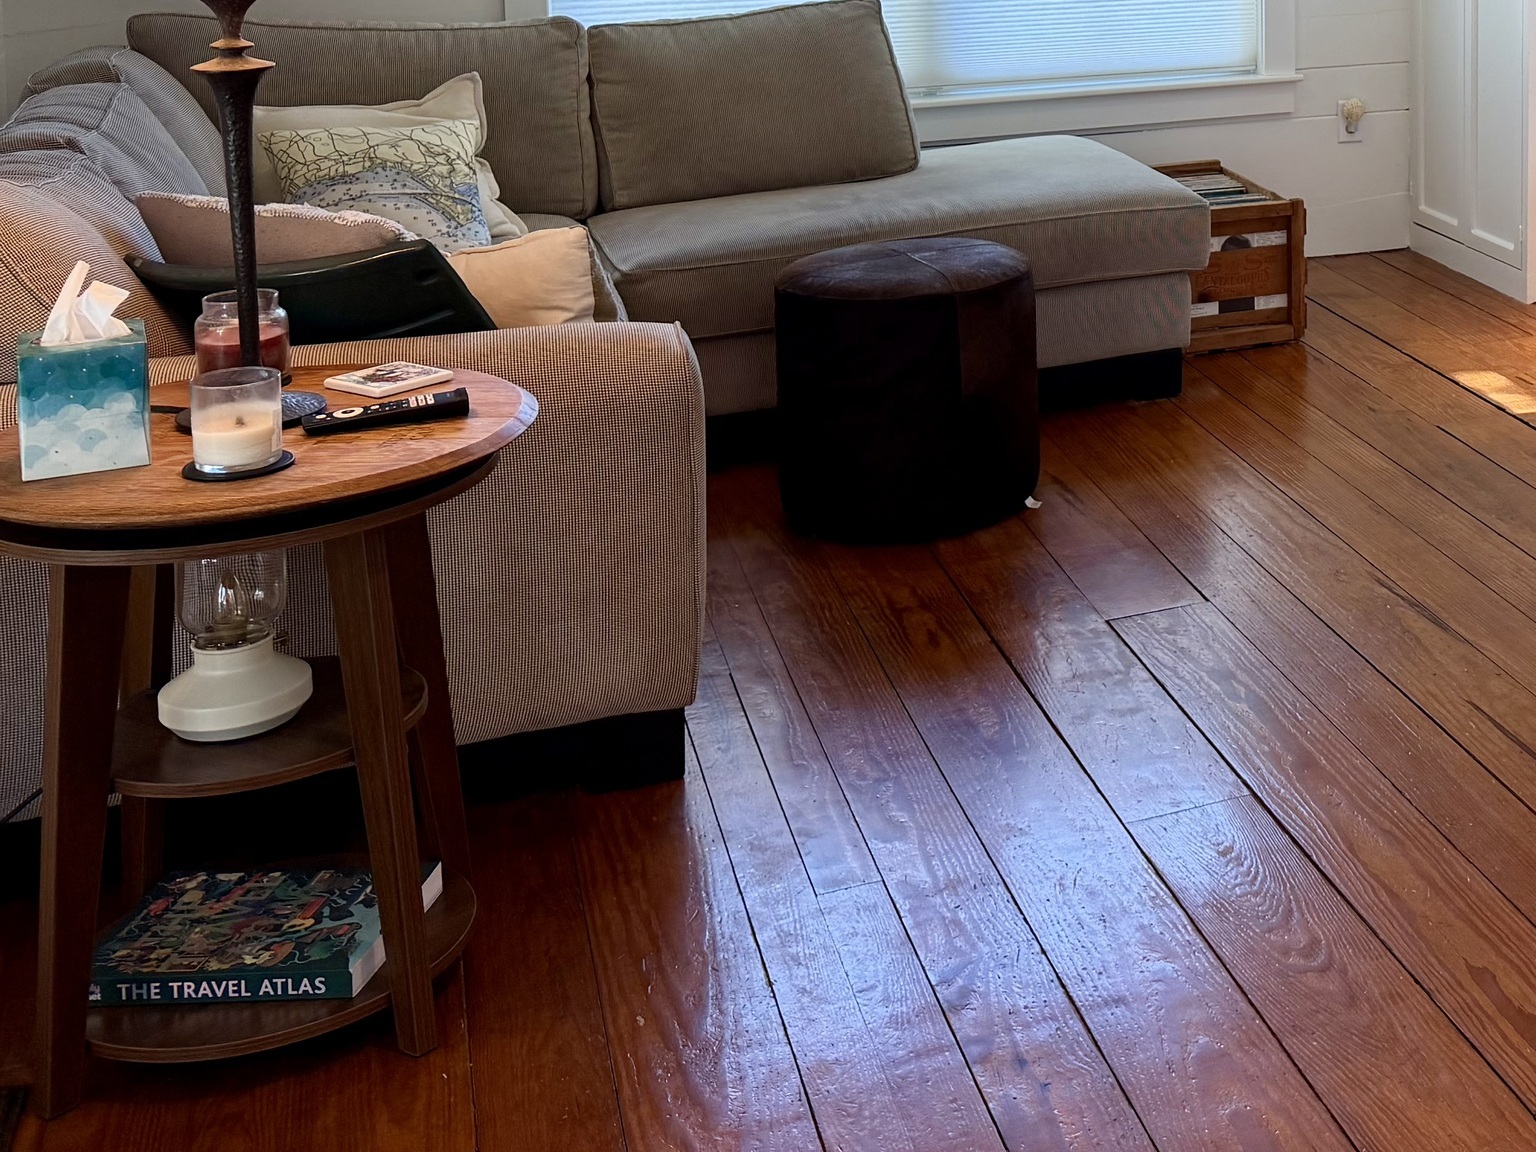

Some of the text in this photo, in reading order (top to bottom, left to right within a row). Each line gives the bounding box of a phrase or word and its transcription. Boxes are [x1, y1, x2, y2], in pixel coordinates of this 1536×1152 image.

[116, 977, 326, 1000] THE TRAVEL ATLAS
